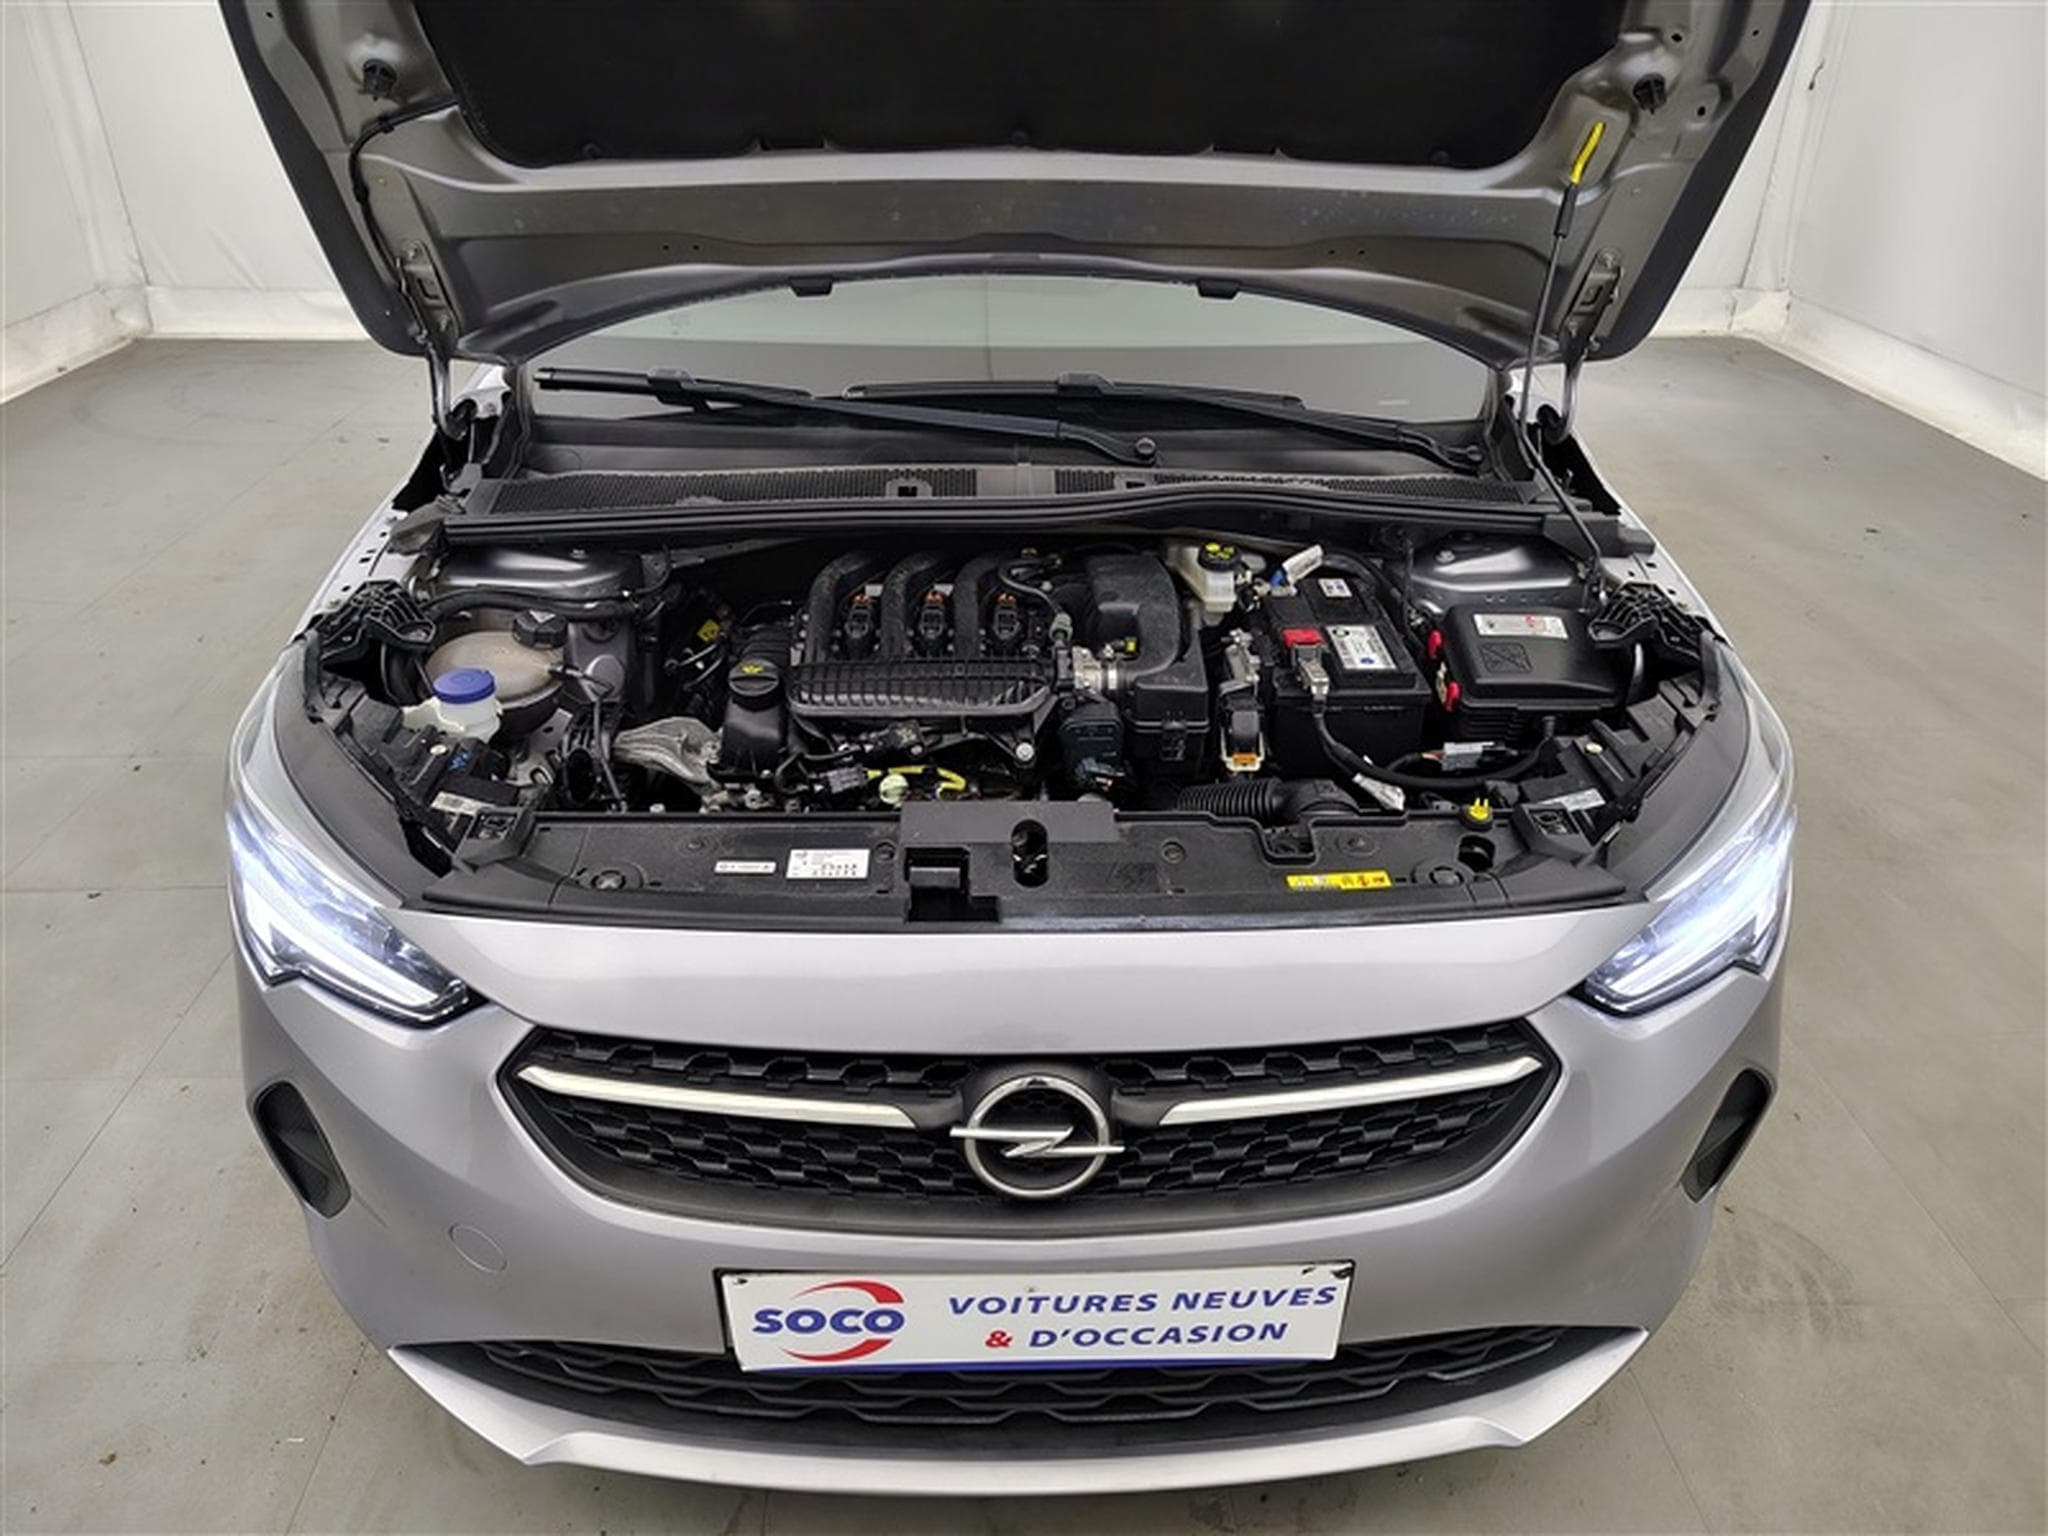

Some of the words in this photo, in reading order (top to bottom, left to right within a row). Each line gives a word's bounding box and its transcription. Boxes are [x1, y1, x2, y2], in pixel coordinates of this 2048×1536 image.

[949, 1294, 1158, 1315] VOITURES
[1172, 1286, 1337, 1311] NEUVES
[752, 1308, 905, 1334] SOCO
[985, 1330, 1012, 1348] &
[1029, 1322, 1288, 1347] D'OCCASION
